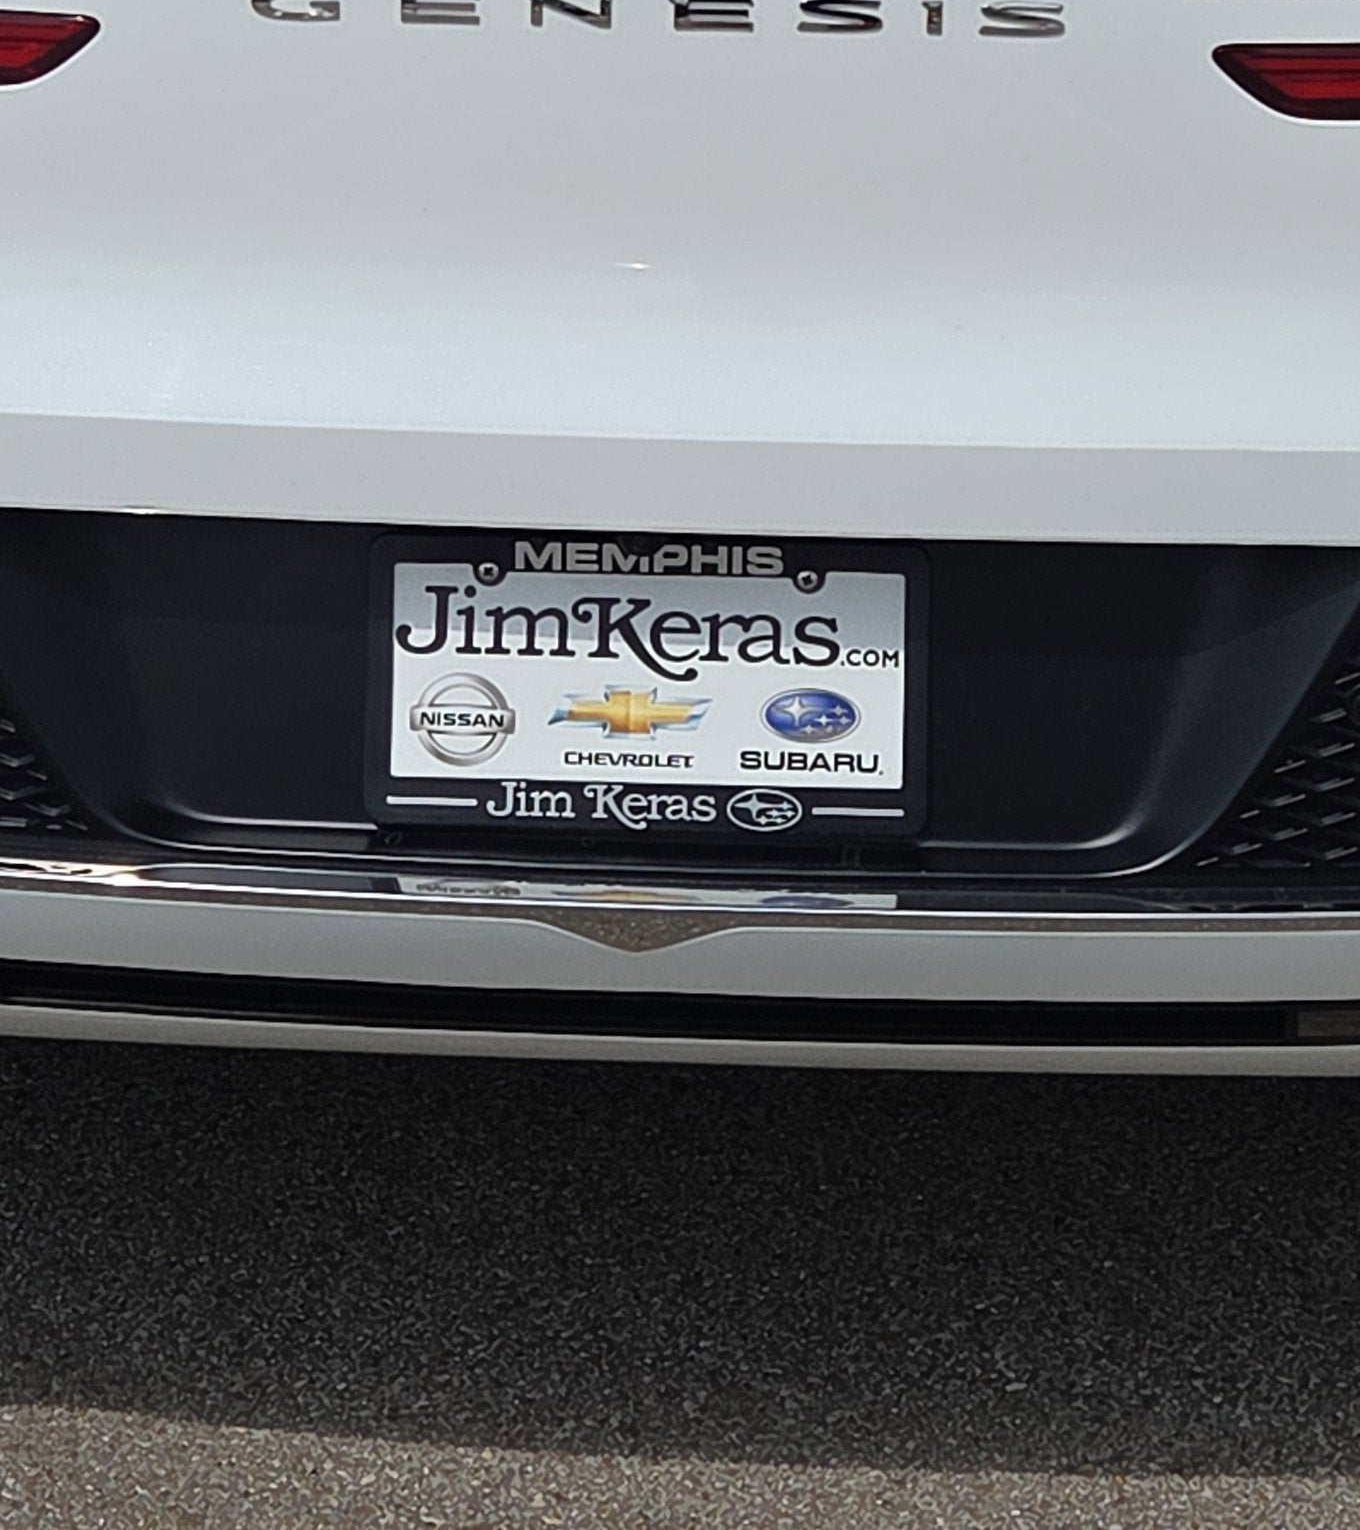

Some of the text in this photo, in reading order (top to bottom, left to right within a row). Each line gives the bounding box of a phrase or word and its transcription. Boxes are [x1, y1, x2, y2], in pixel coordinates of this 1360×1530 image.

[514, 541, 785, 576] MEMPHIS
[419, 711, 505, 728] NISSAN
[563, 751, 695, 769] CHEVROLET
[739, 750, 880, 774] SUBARU
[485, 781, 718, 830] Jim Keras
